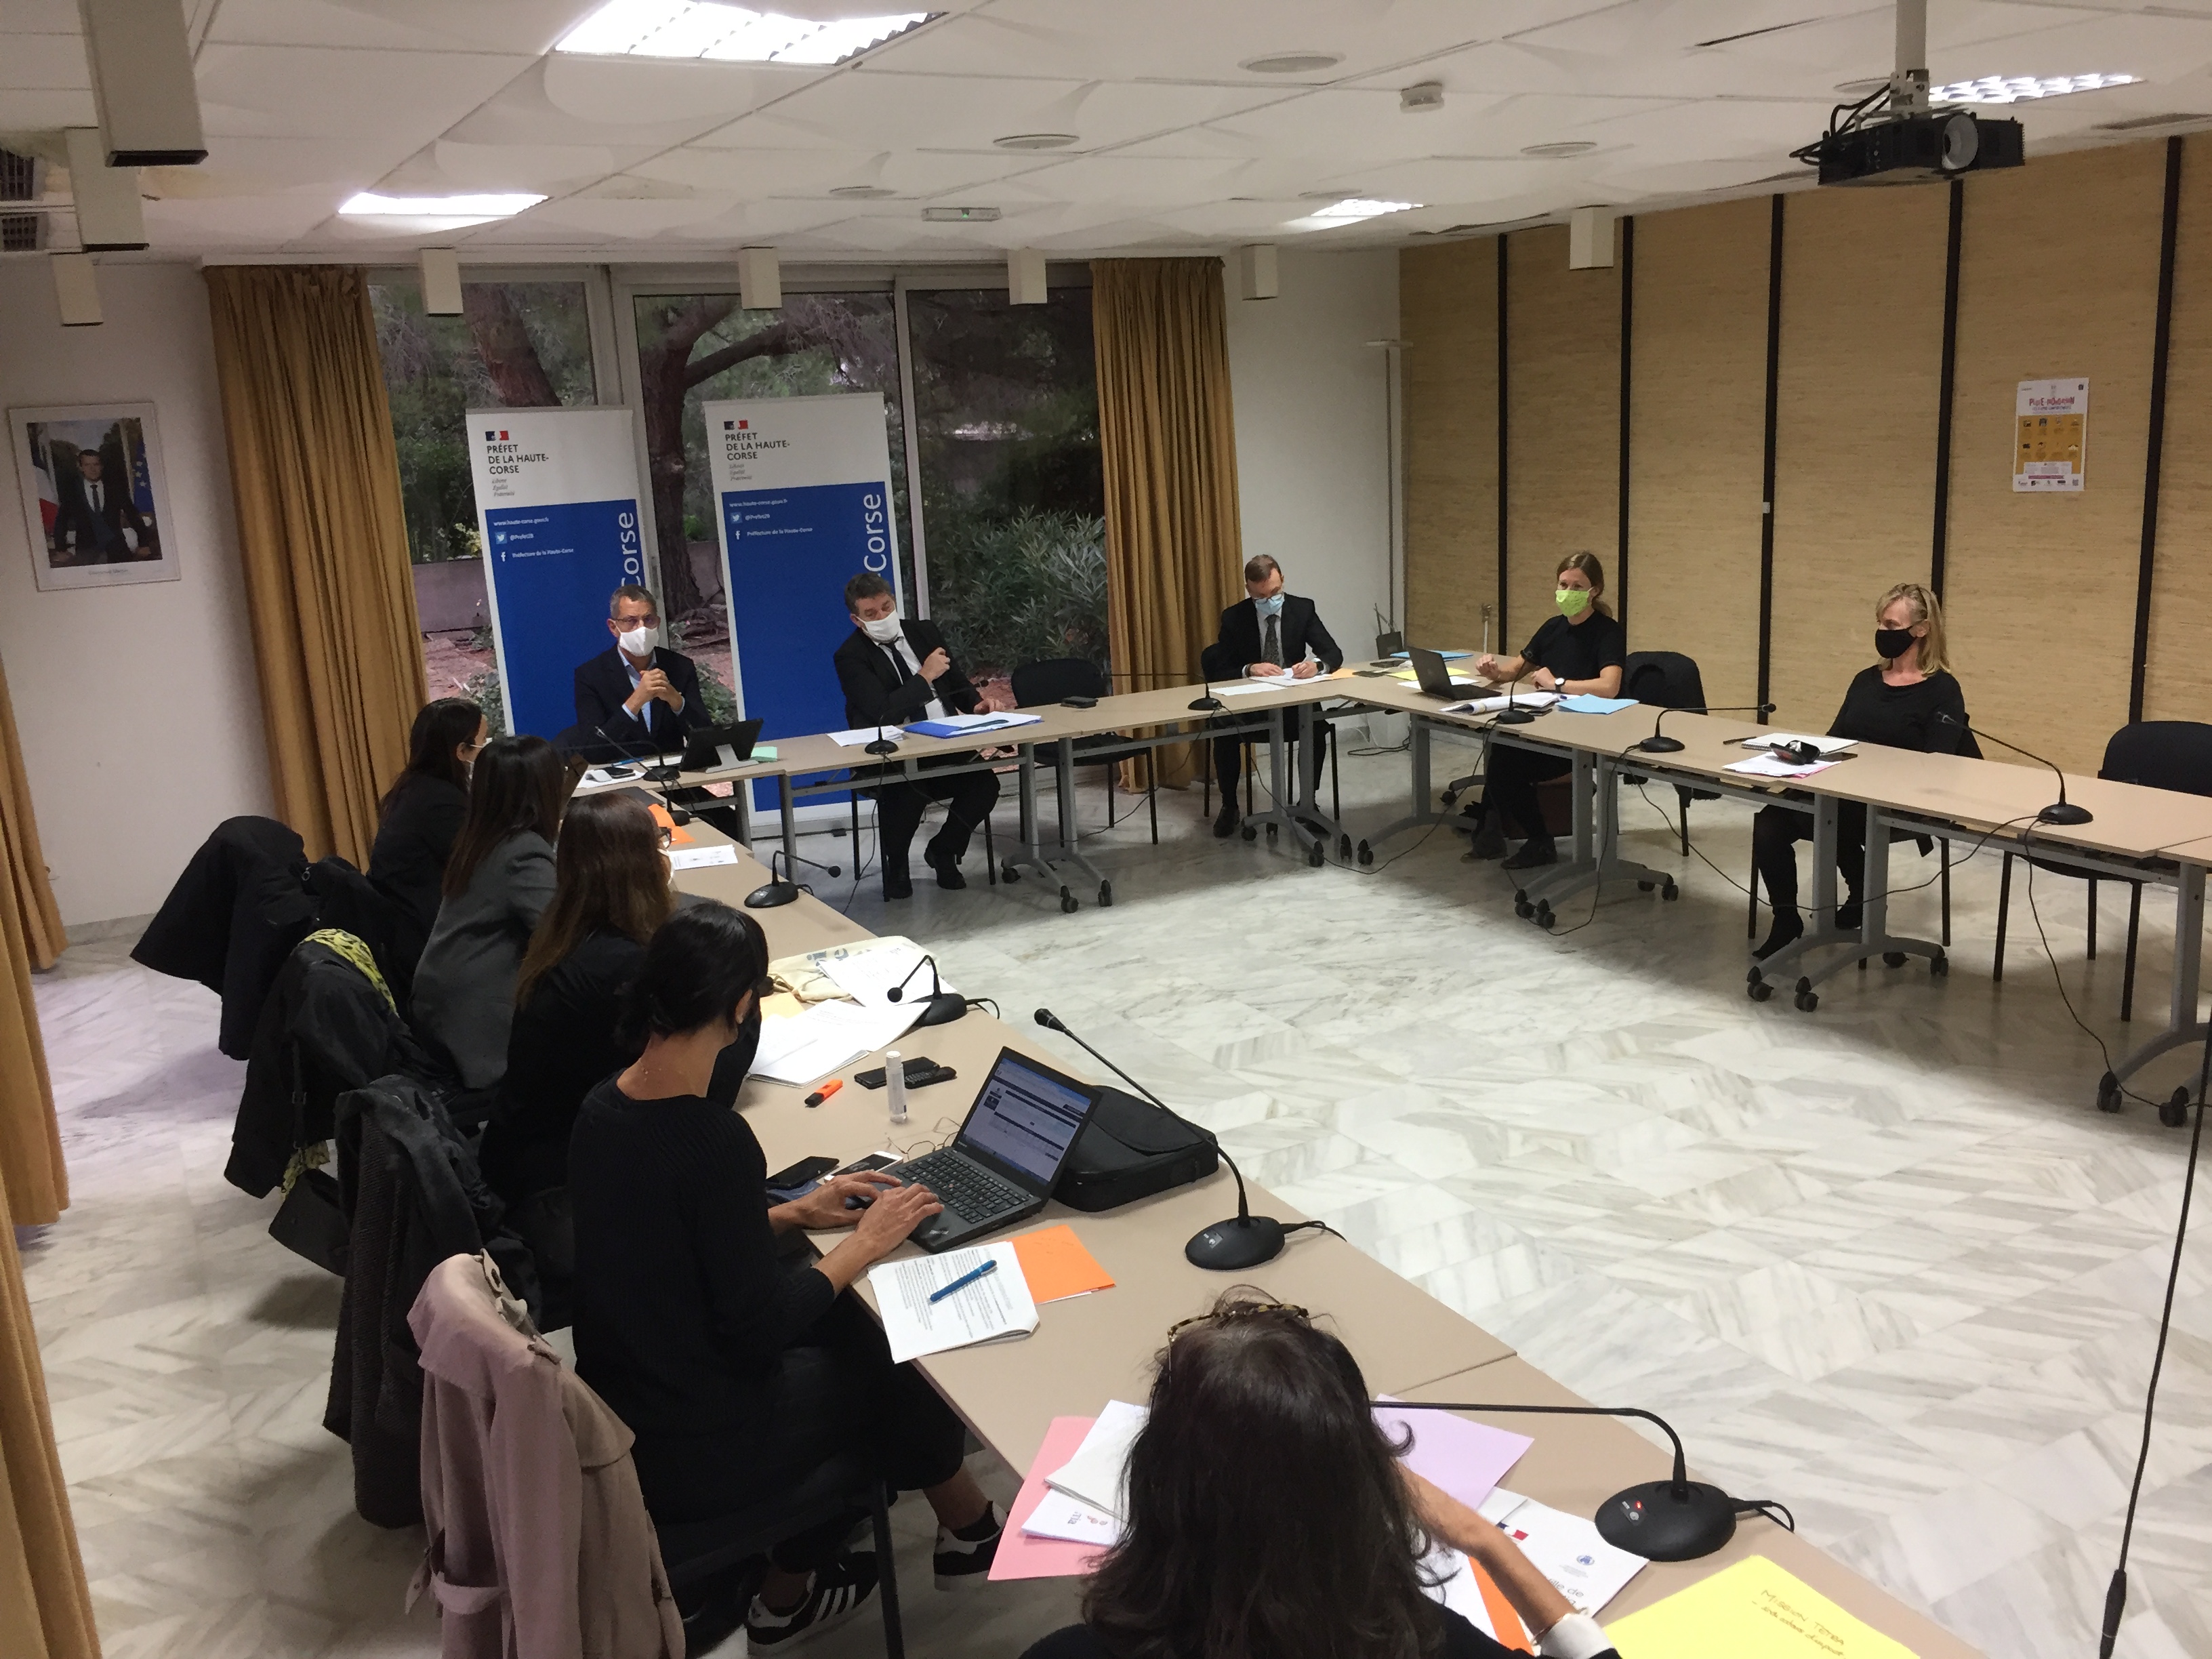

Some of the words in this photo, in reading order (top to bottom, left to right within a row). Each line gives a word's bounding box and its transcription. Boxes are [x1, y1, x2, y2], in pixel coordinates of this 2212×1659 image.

[725, 432, 758, 441] PRÉFET
[487, 443, 518, 453] PRÉFET
[756, 440, 790, 449] HAUTE-
[488, 455, 500, 464] DE
[503, 455, 514, 463] LA
[516, 453, 549, 462] HAUTE-
[726, 451, 758, 461] CORSE
[489, 465, 519, 474] CORSE
[1568, 1586, 1584, 1598] de
